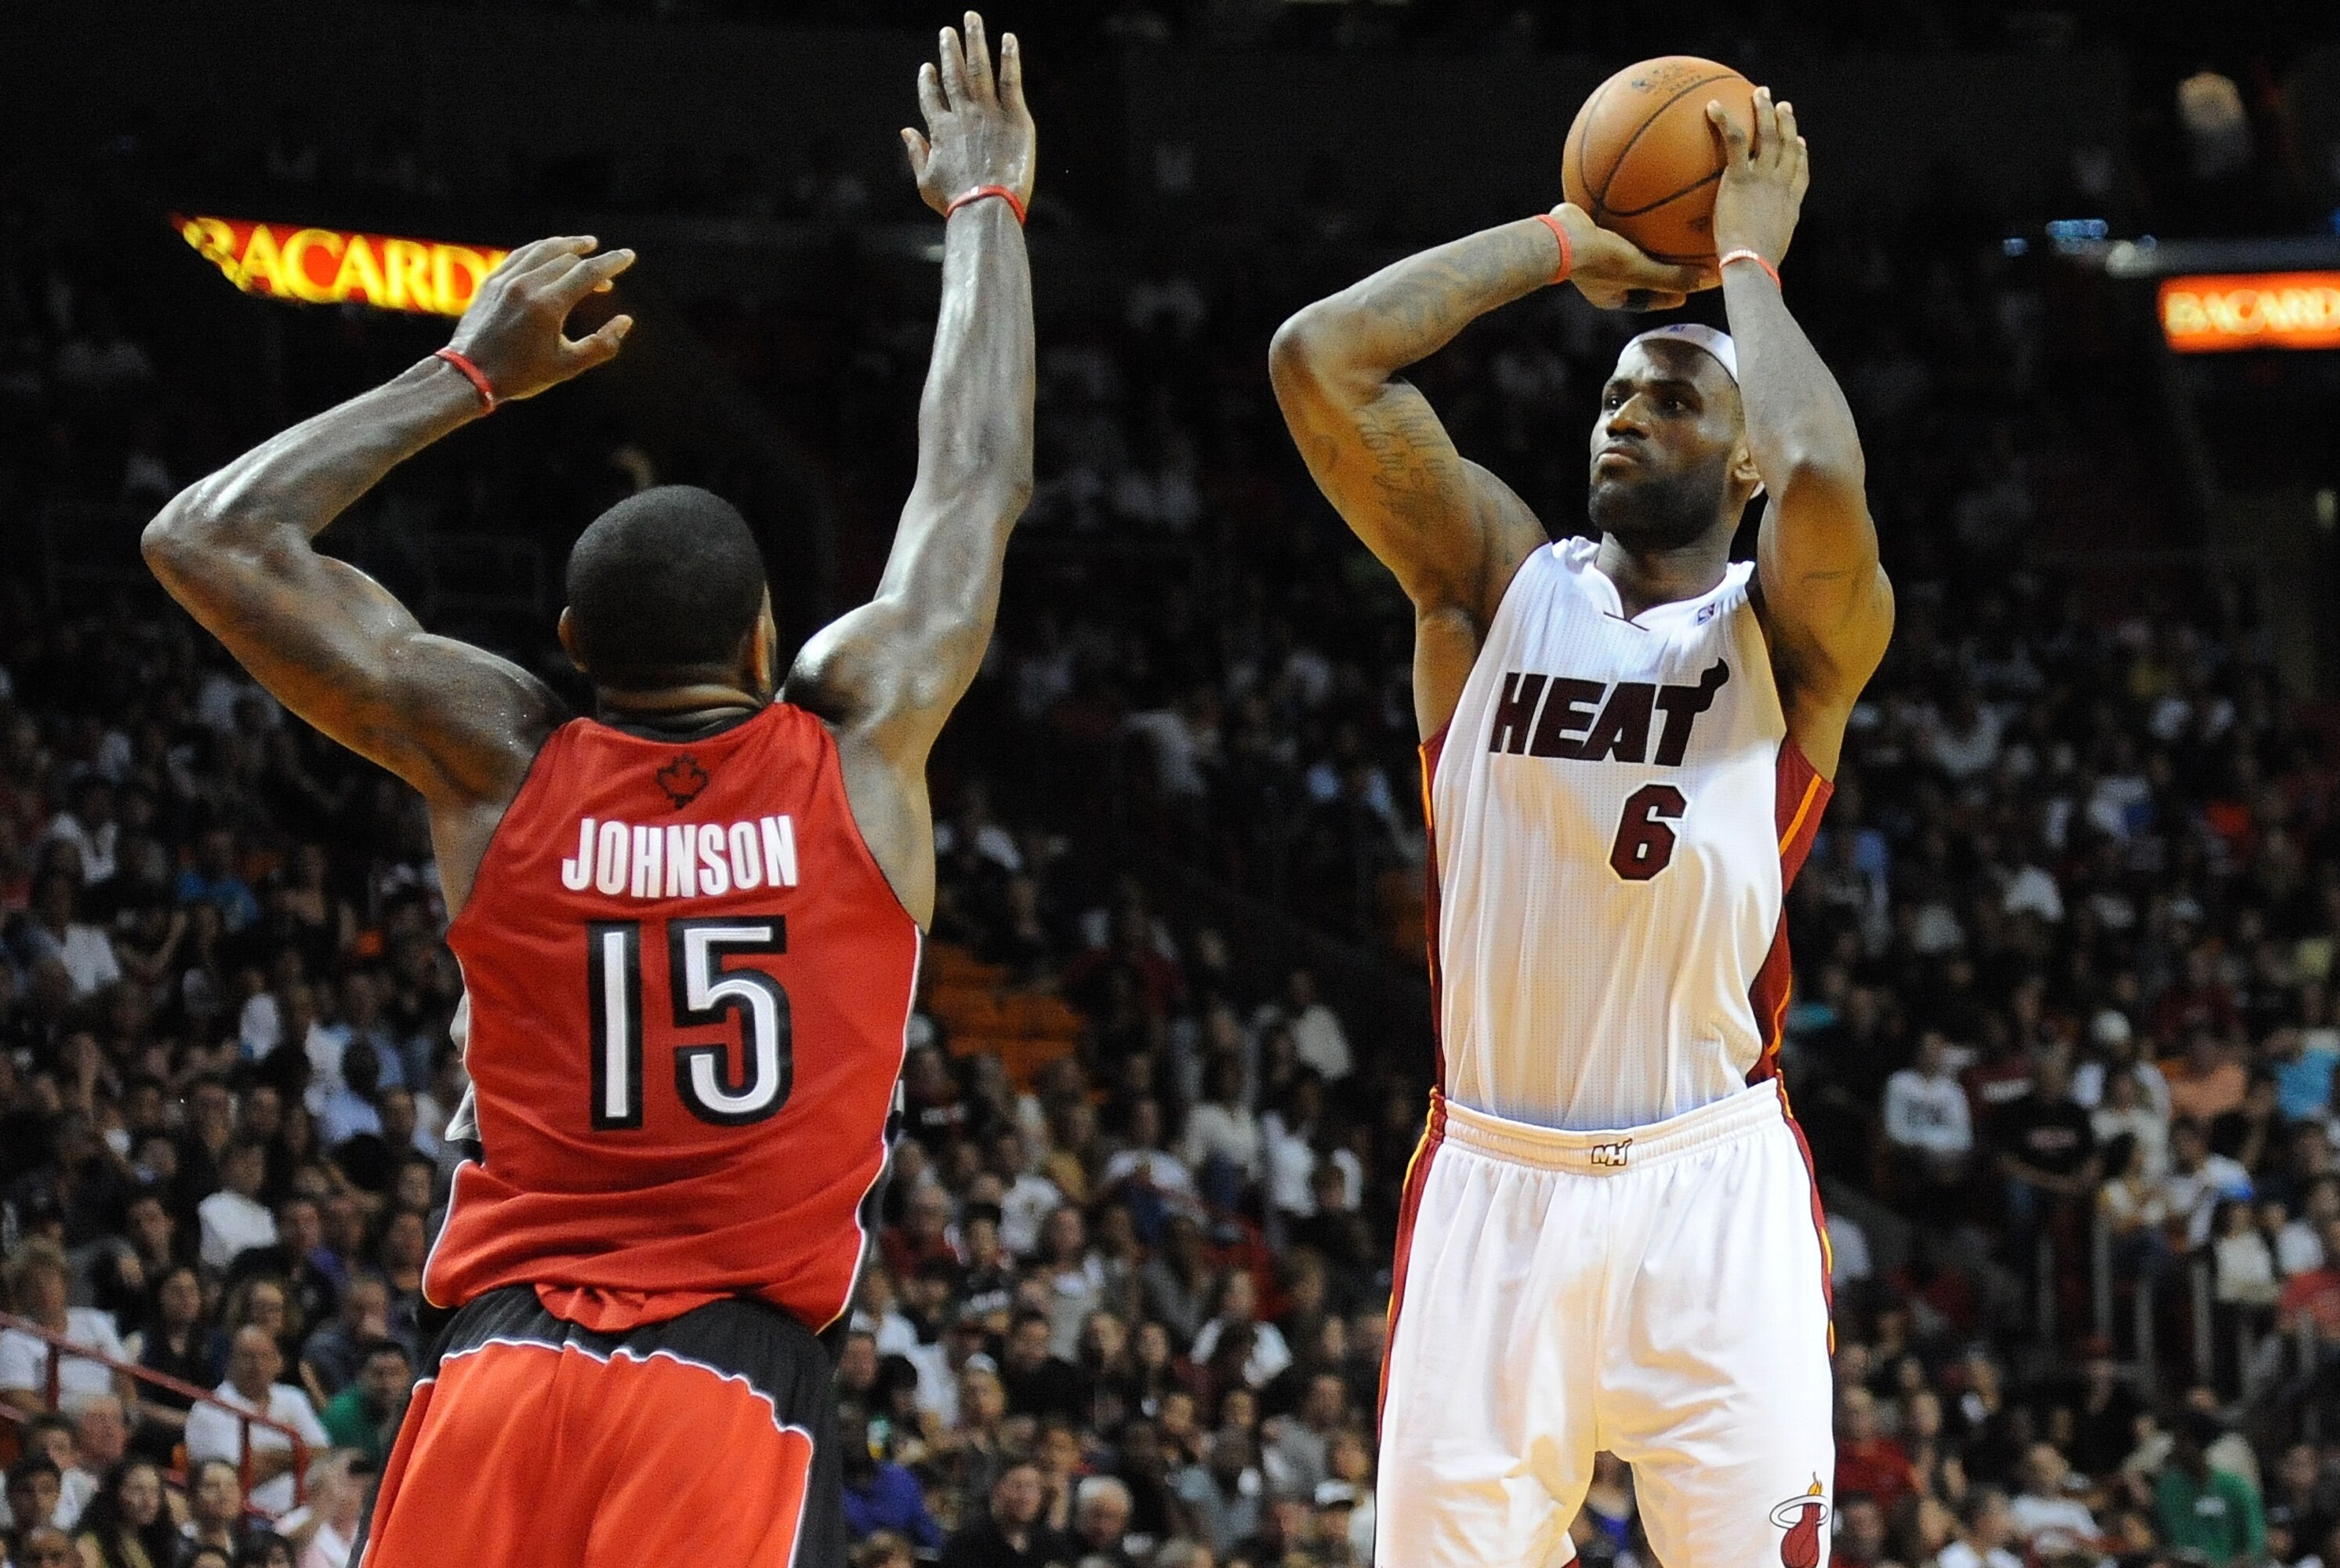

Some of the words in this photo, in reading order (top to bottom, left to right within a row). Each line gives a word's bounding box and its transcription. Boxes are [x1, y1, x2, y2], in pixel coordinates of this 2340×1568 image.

[1489, 657, 1729, 767] HEAT
[561, 815, 798, 898] JOHNSON
[1609, 783, 1688, 881] 6
[586, 915, 793, 1131] 15
